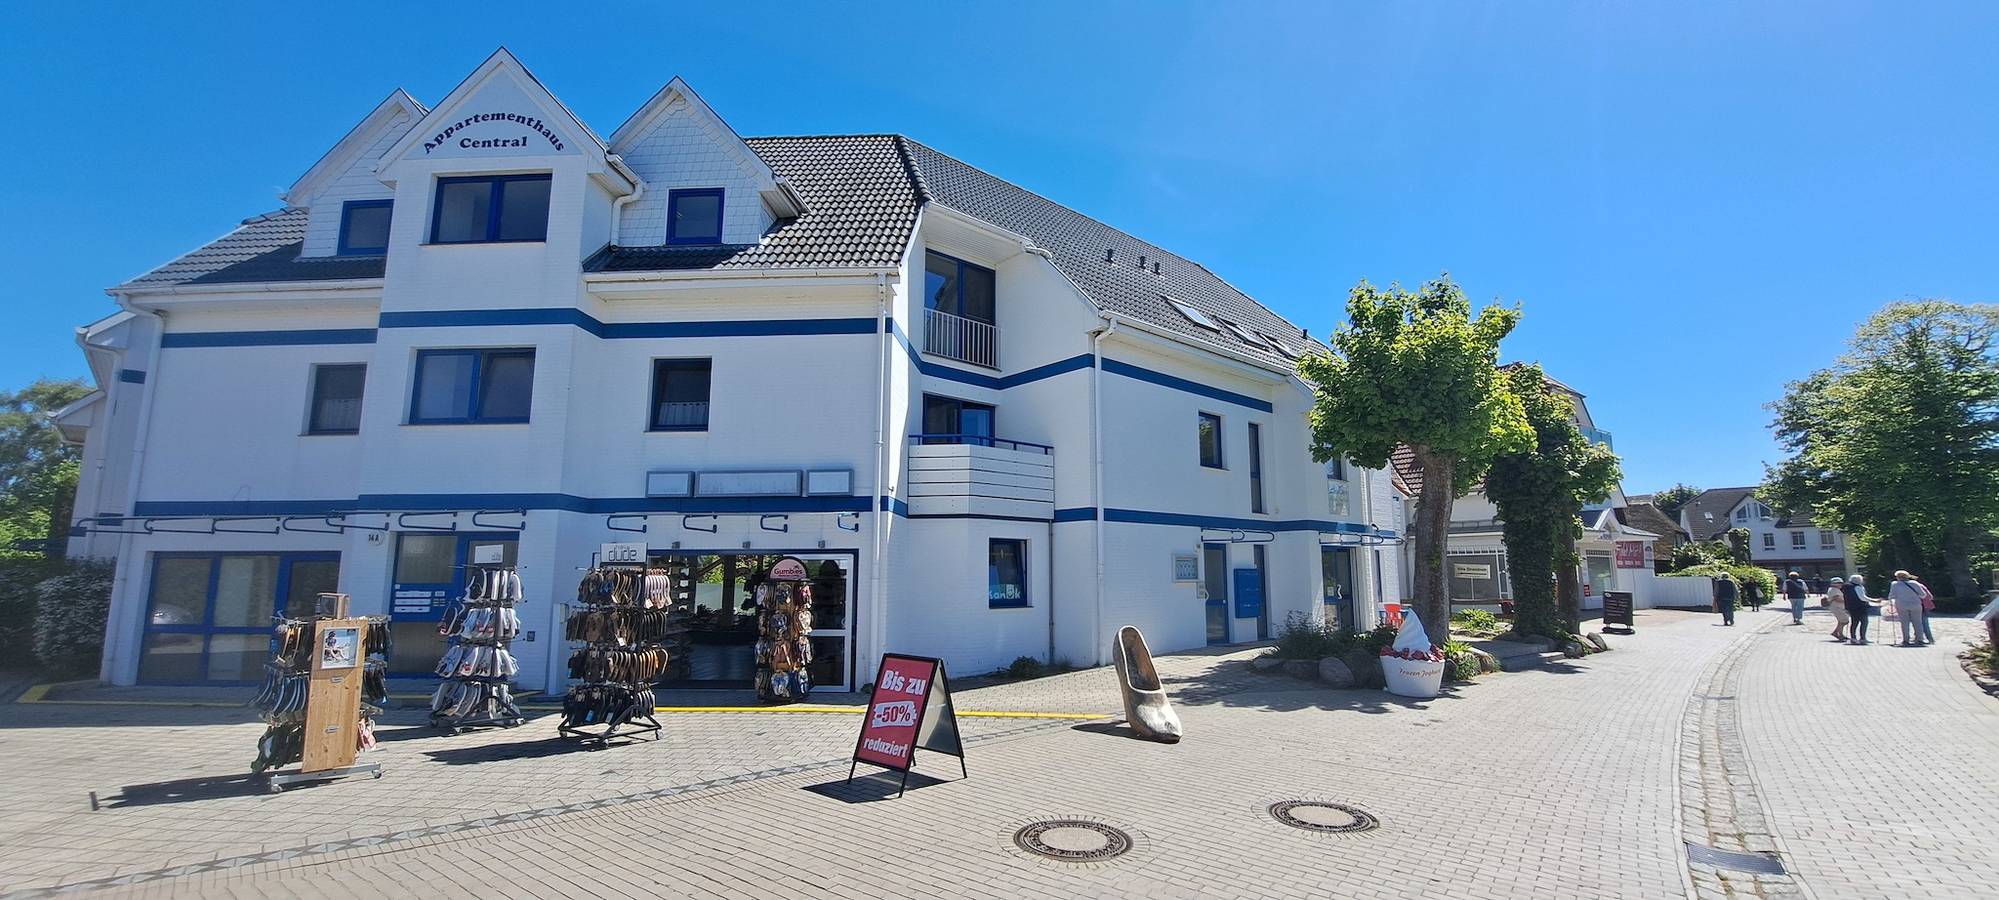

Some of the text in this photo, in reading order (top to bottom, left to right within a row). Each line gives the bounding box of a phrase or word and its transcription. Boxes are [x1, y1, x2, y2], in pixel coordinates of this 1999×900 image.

[423, 112, 565, 154] Appartementhaus
[459, 136, 527, 149] Central
[881, 669, 927, 696] Bis zu
[877, 705, 911, 722] -50%
[863, 737, 909, 758] reduziert
